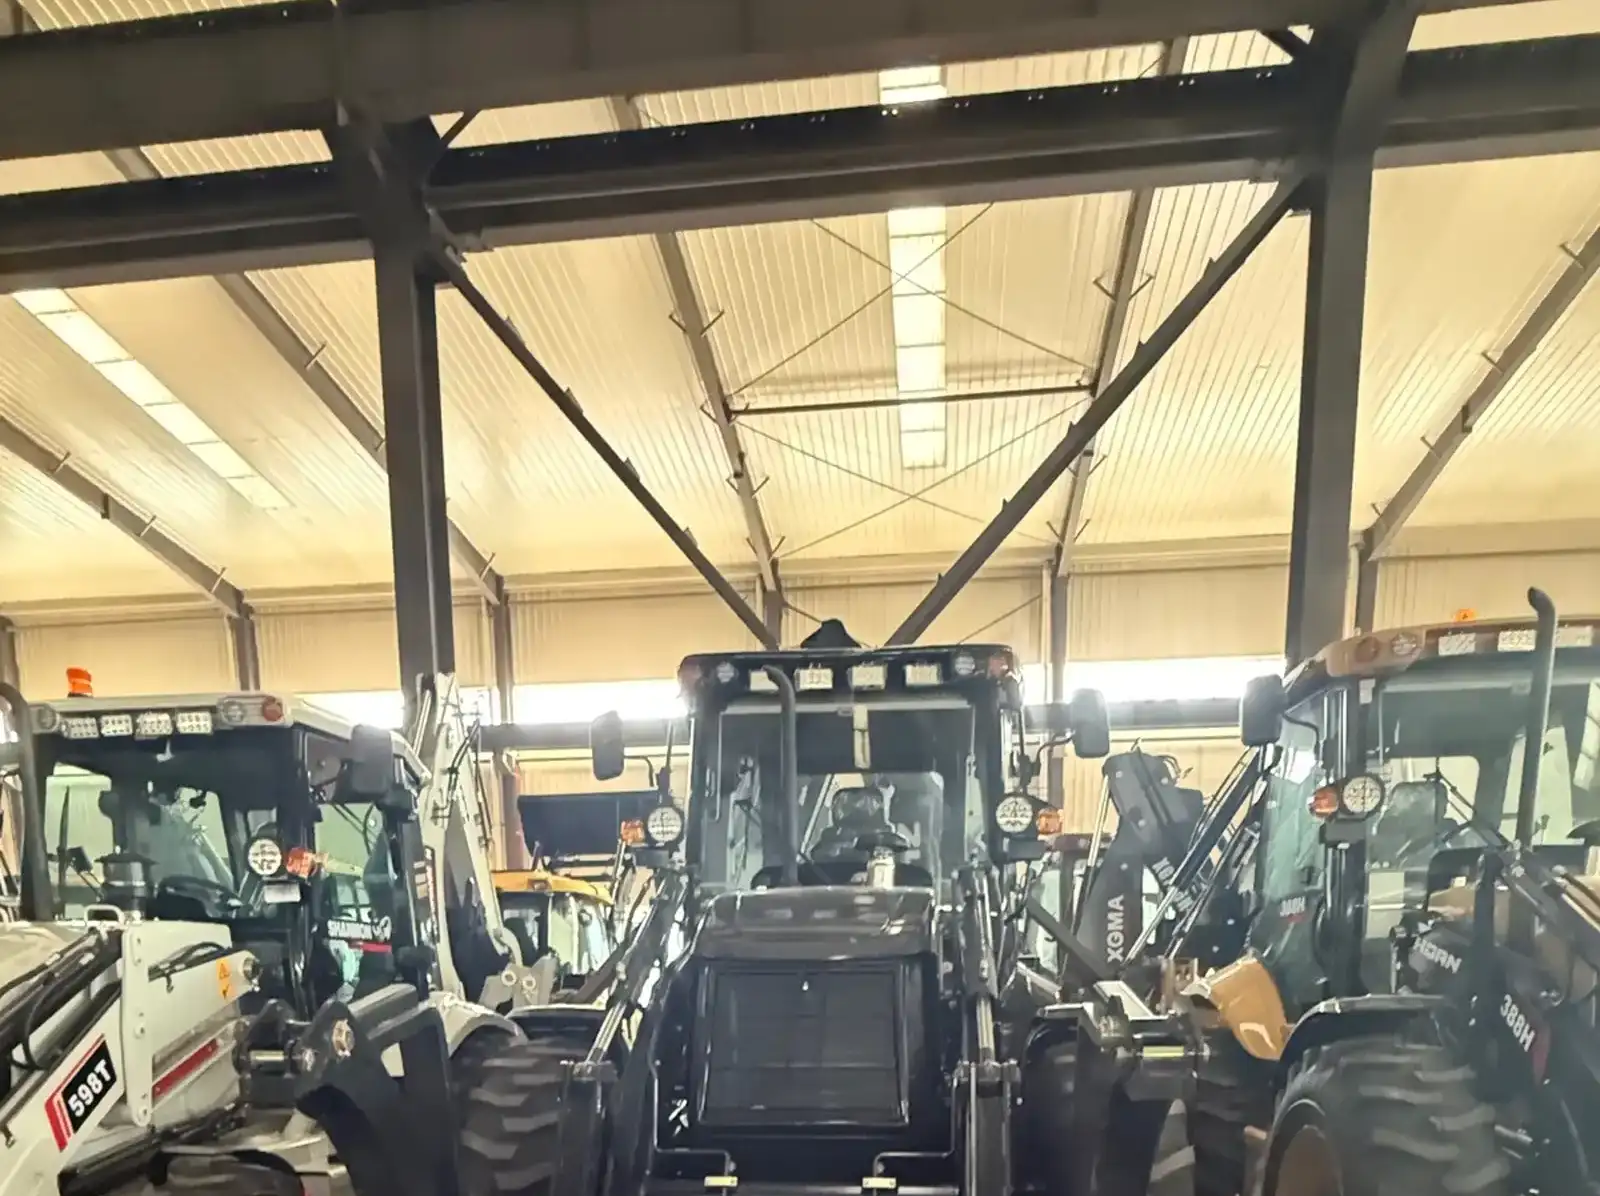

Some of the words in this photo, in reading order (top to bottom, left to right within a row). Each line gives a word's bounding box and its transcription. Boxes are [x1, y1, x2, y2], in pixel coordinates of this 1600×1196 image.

[1107, 894, 1125, 963] XGMA
[1500, 994, 1535, 1052] 388H
[68, 1059, 111, 1117] 598T
